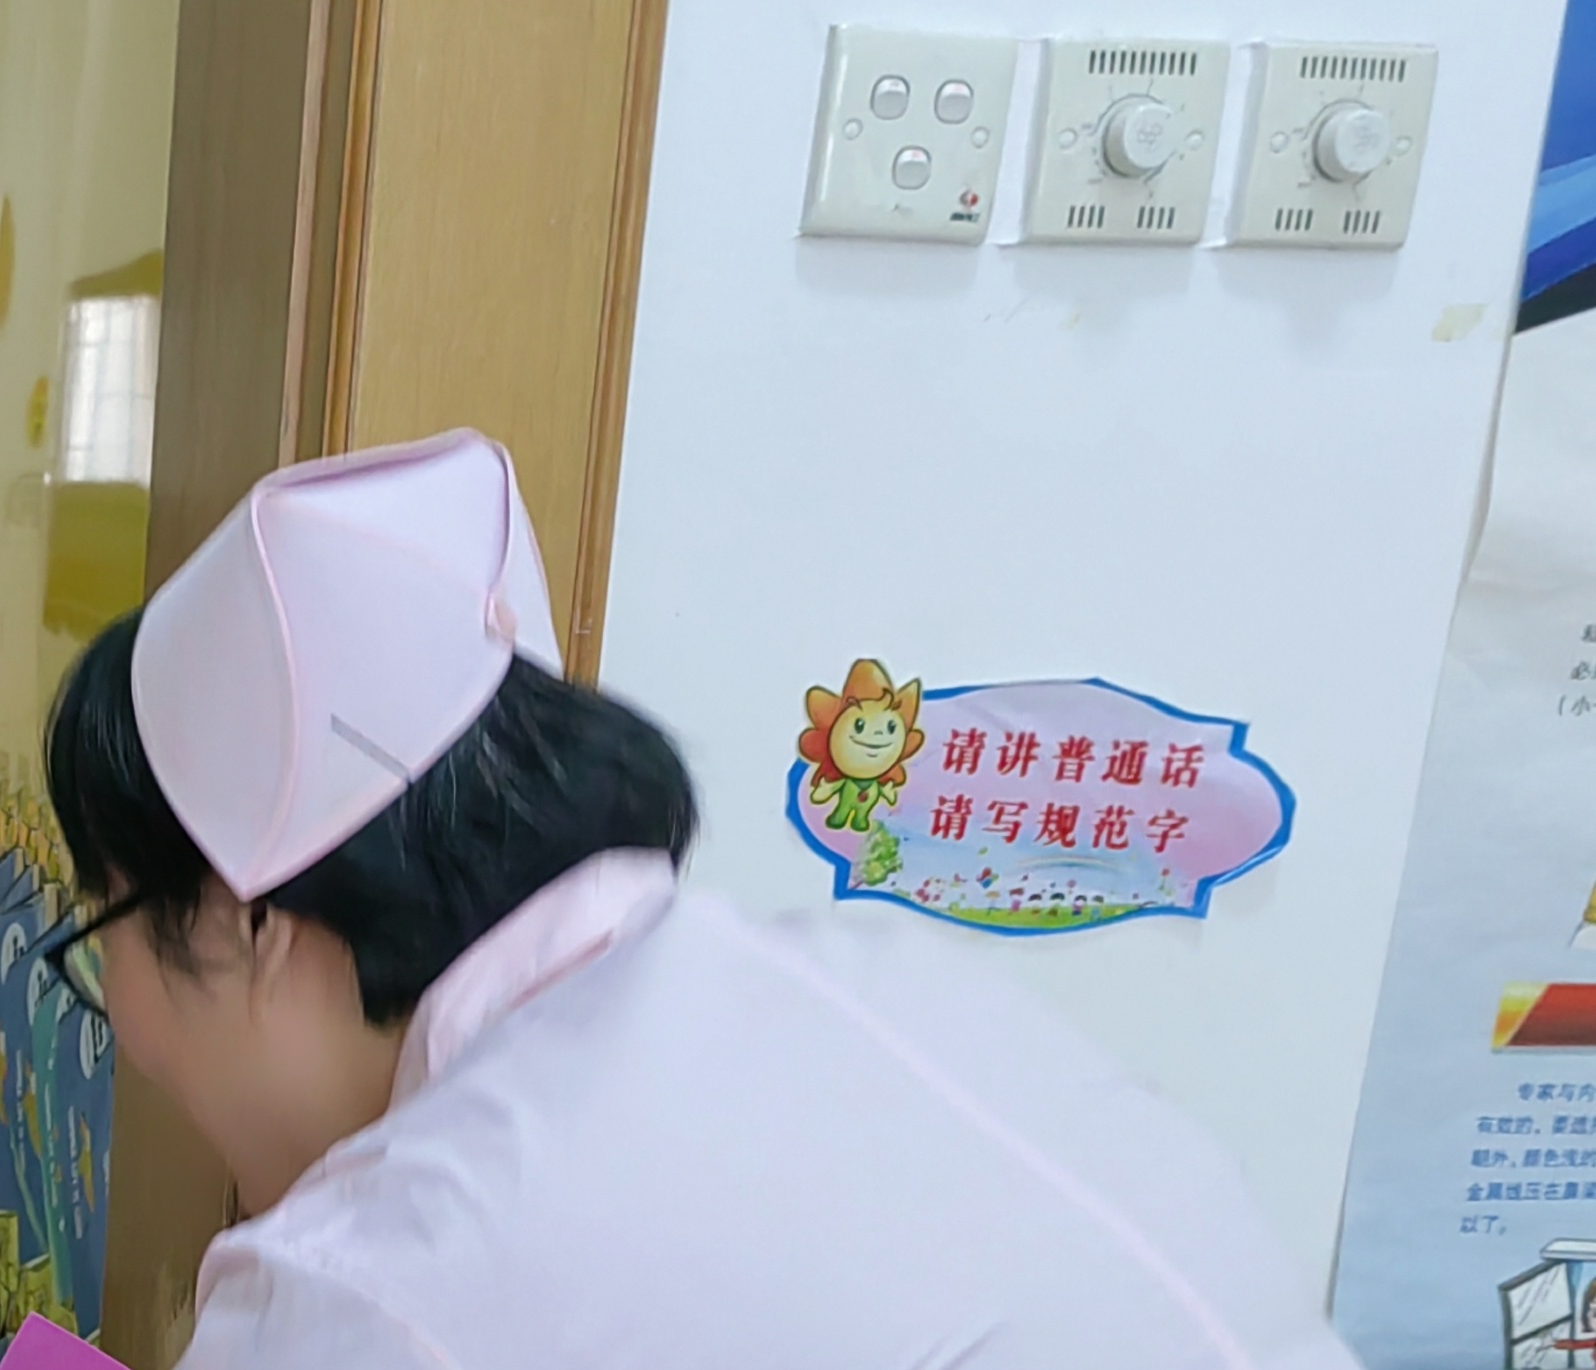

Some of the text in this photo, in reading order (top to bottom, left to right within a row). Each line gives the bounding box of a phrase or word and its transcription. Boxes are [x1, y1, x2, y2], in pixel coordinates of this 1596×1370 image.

[941, 728, 1207, 789] 请讲普通话
[928, 794, 1190, 854] 请写规范字
